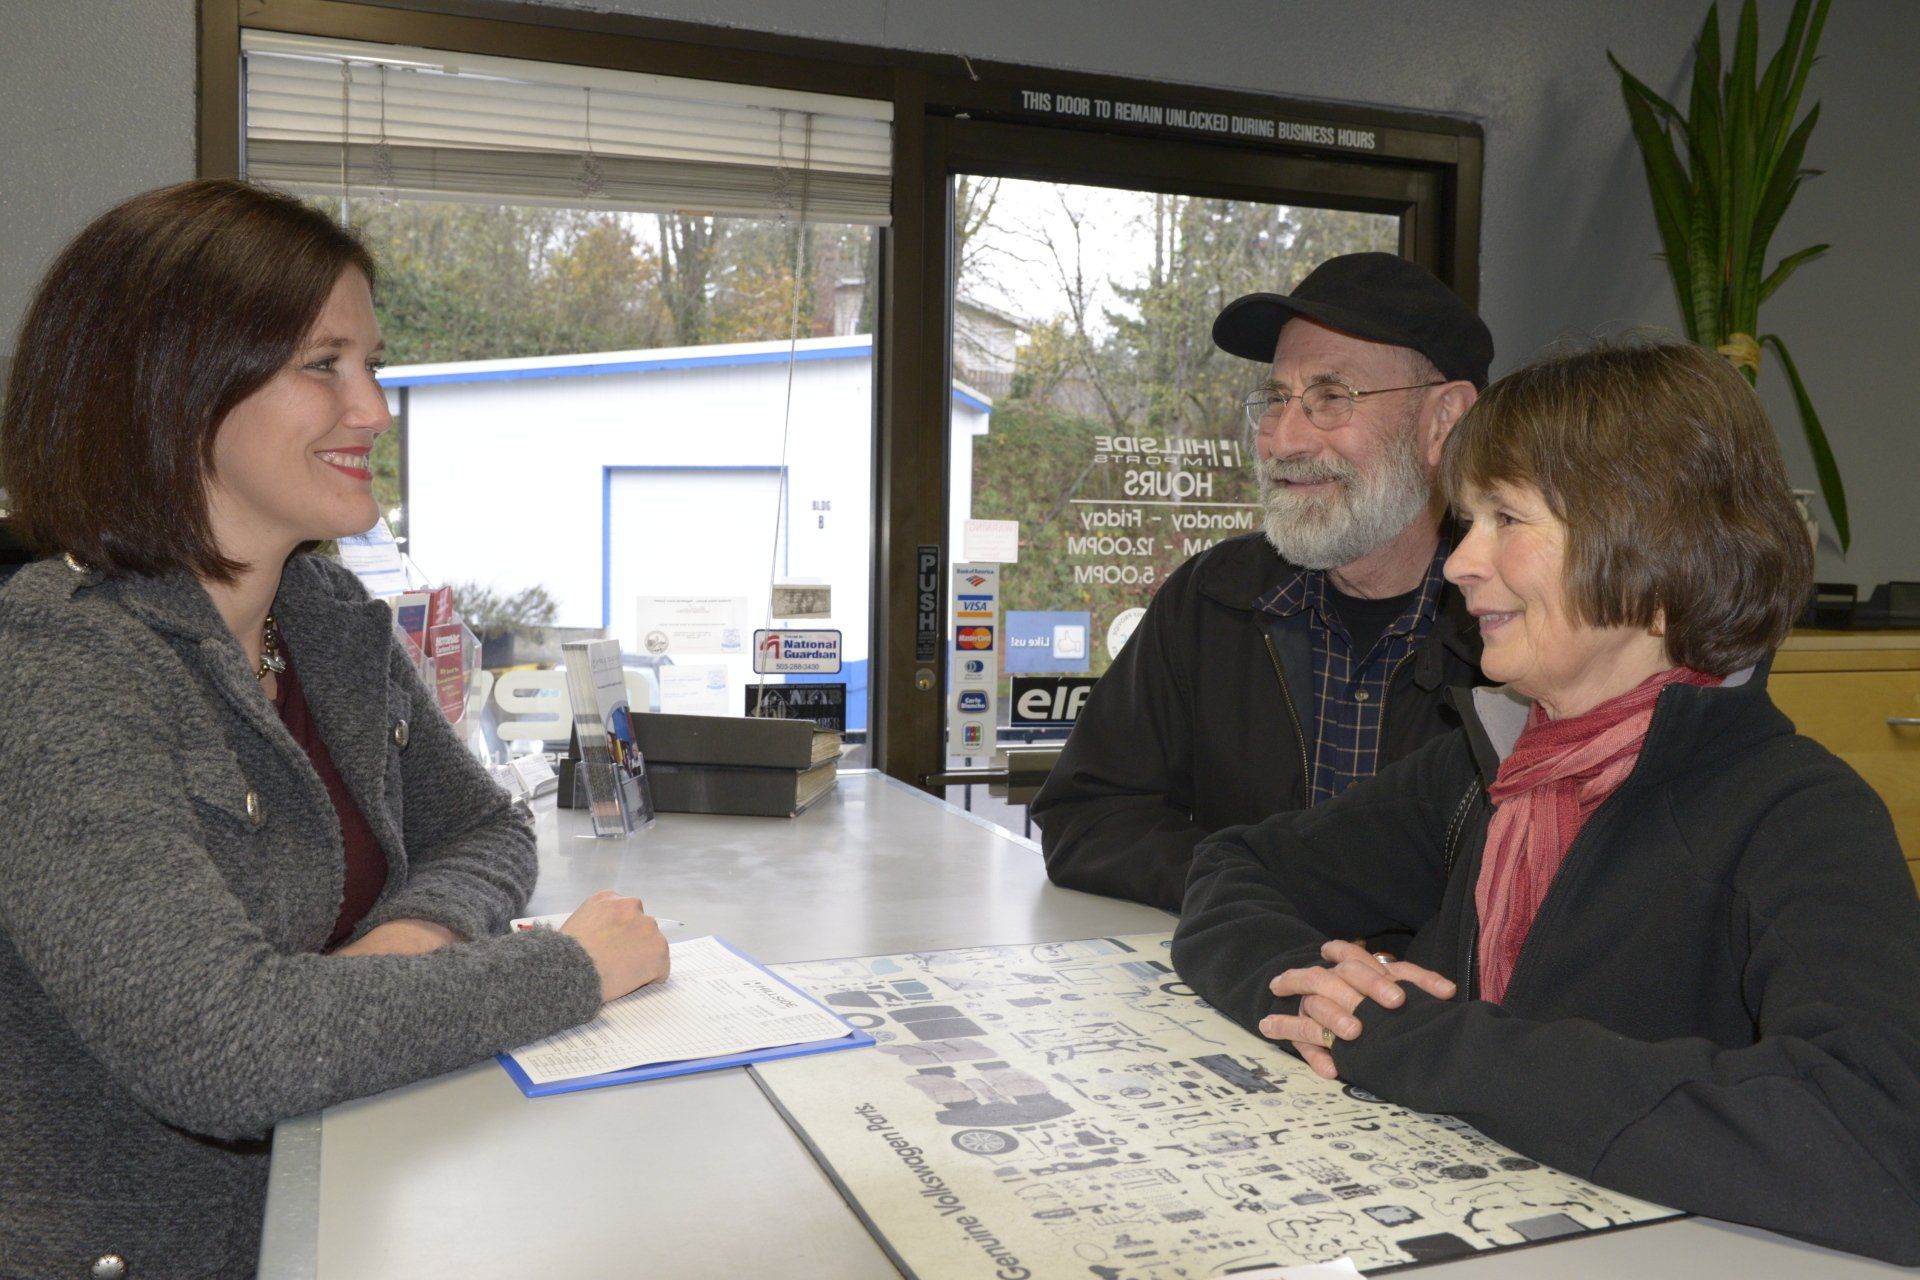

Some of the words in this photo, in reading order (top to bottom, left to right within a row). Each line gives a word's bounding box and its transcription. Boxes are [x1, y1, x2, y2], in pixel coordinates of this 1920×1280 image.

[1021, 90, 1051, 112] THIS
[1055, 95, 1090, 117] DOOR
[1094, 99, 1112, 119] TO
[1114, 103, 1162, 126] REMAIN
[1165, 108, 1228, 133] UNLOCKED
[1231, 116, 1275, 139] DURING
[1277, 121, 1335, 146] BUSINESS
[1337, 128, 1376, 150] HOURS
[918, 554, 937, 631] PUSH
[963, 601, 987, 611] VISA
[784, 639, 837, 649] National
[958, 634, 992, 643] MasterCard
[784, 650, 837, 660] Guardian
[1017, 686, 1092, 721] elf
[854, 1102, 885, 1132] Parts.
[882, 1132, 966, 1217] Volkswagen
[957, 1214, 1032, 1280] Genuine
